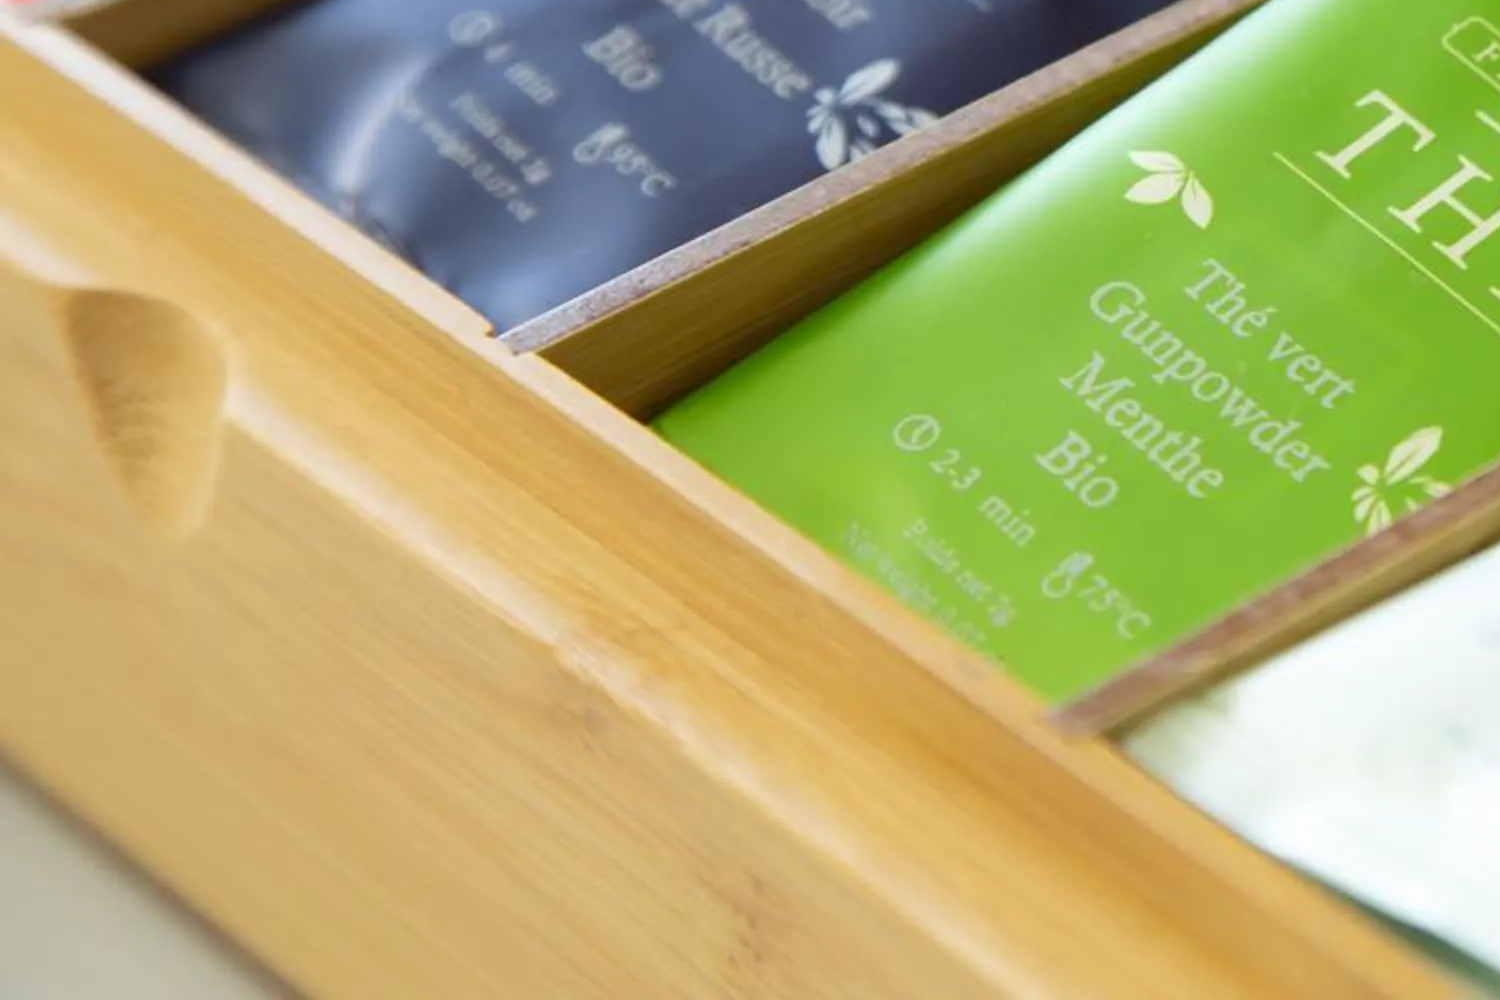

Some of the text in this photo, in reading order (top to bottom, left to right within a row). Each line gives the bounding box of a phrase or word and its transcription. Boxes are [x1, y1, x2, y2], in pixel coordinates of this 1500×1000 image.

[581, 24, 663, 91] Bio
[694, 1, 817, 99] Russe
[1182, 257, 1357, 408] Thé vert
[1059, 351, 1225, 500] Menthe
[1090, 281, 1331, 484] Gunpowder
[930, 449, 1036, 547] 2-3 min
[1035, 430, 1120, 509] Bio
